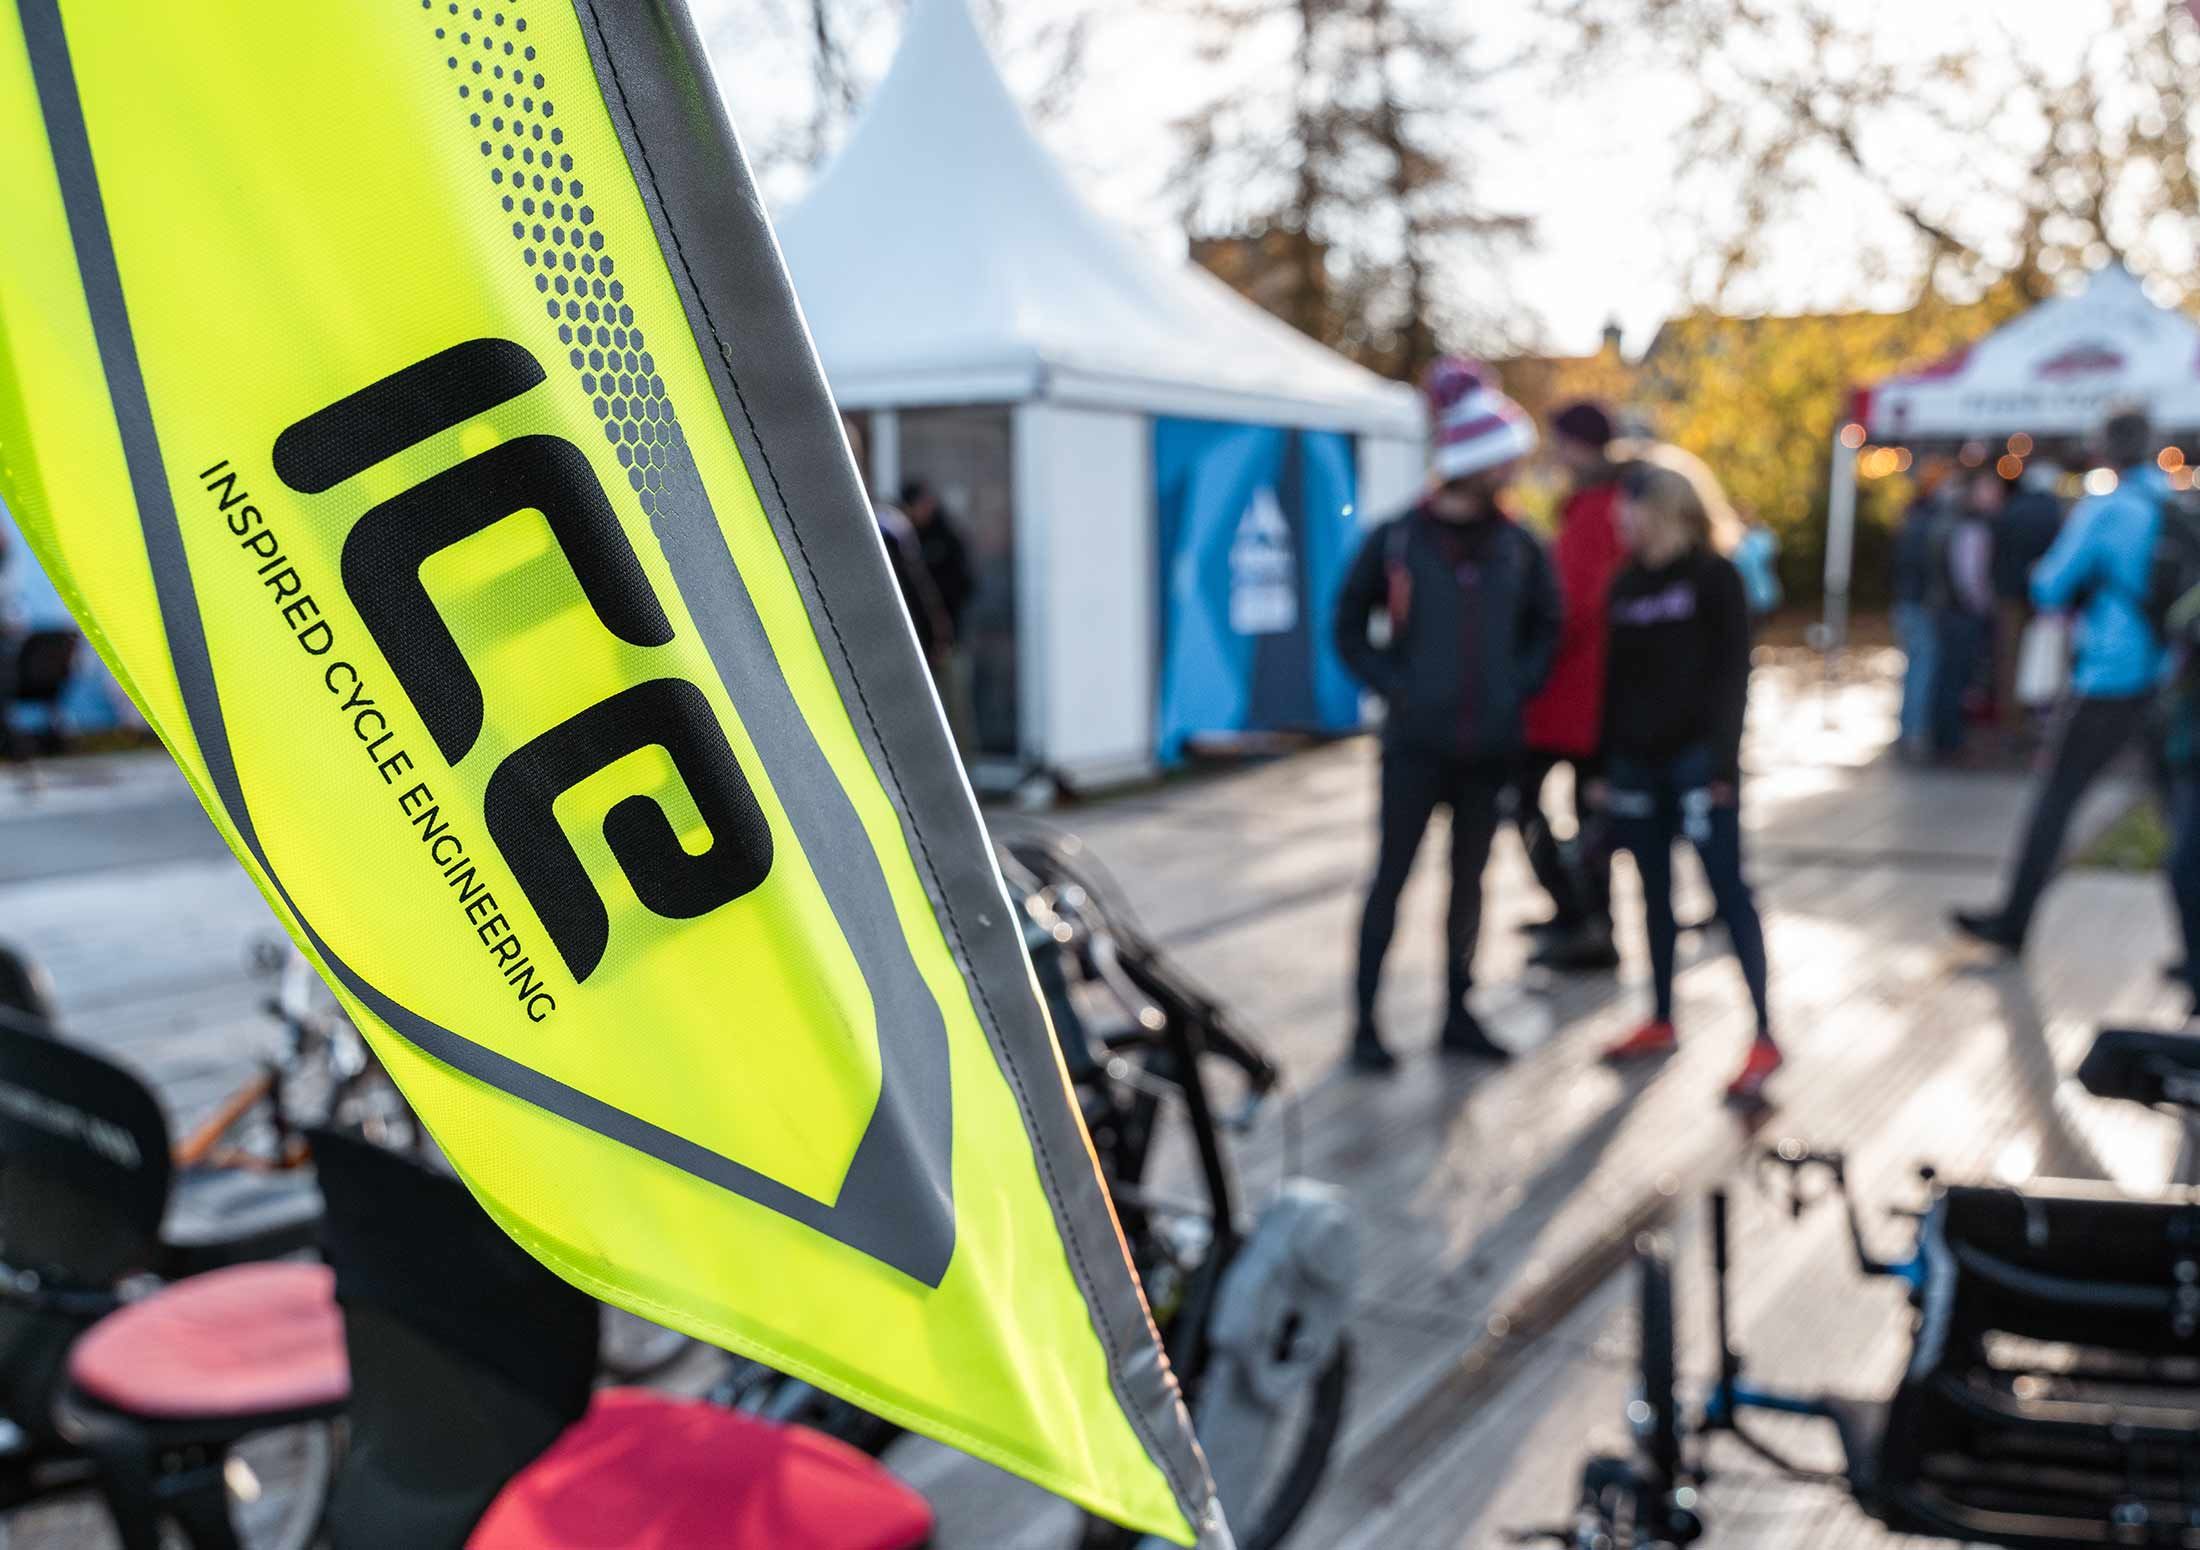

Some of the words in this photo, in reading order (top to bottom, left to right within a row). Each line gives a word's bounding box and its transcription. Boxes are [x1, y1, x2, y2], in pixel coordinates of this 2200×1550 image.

[199, 459, 334, 657] INSPIRED
[323, 660, 414, 785] CYCLE
[398, 782, 557, 1024] ENGINEERING
